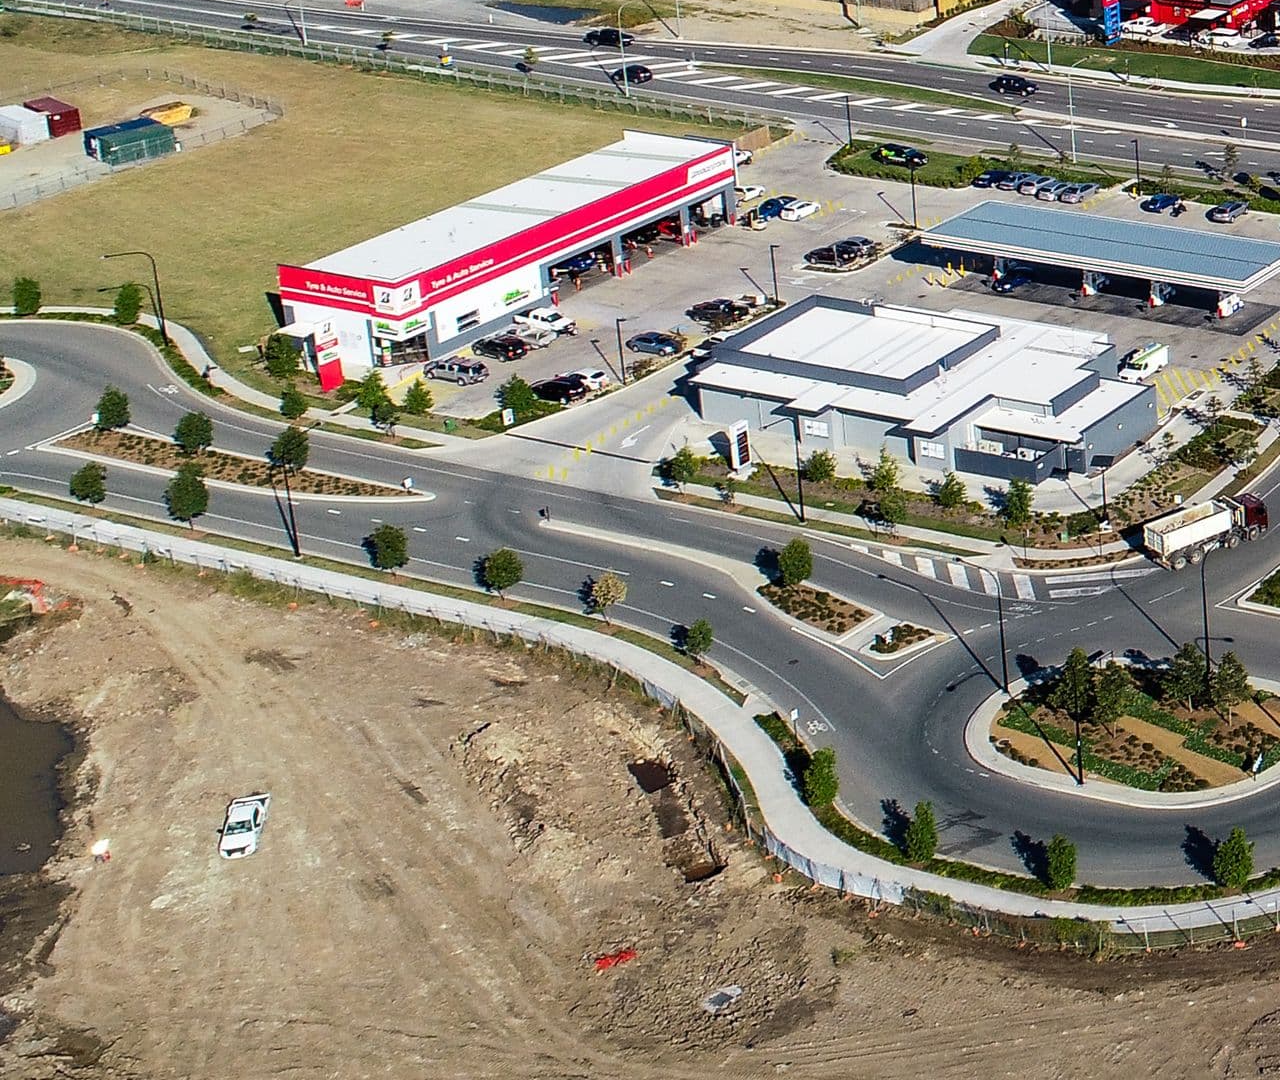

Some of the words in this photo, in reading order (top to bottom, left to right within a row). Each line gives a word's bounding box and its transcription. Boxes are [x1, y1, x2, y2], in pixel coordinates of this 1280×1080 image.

[430, 279, 446, 289] Tyre
[452, 269, 468, 280] Auto
[469, 259, 495, 272] Service
[305, 281, 319, 292] Tyre
[326, 284, 343, 295] Auto
[343, 287, 368, 299] Service
